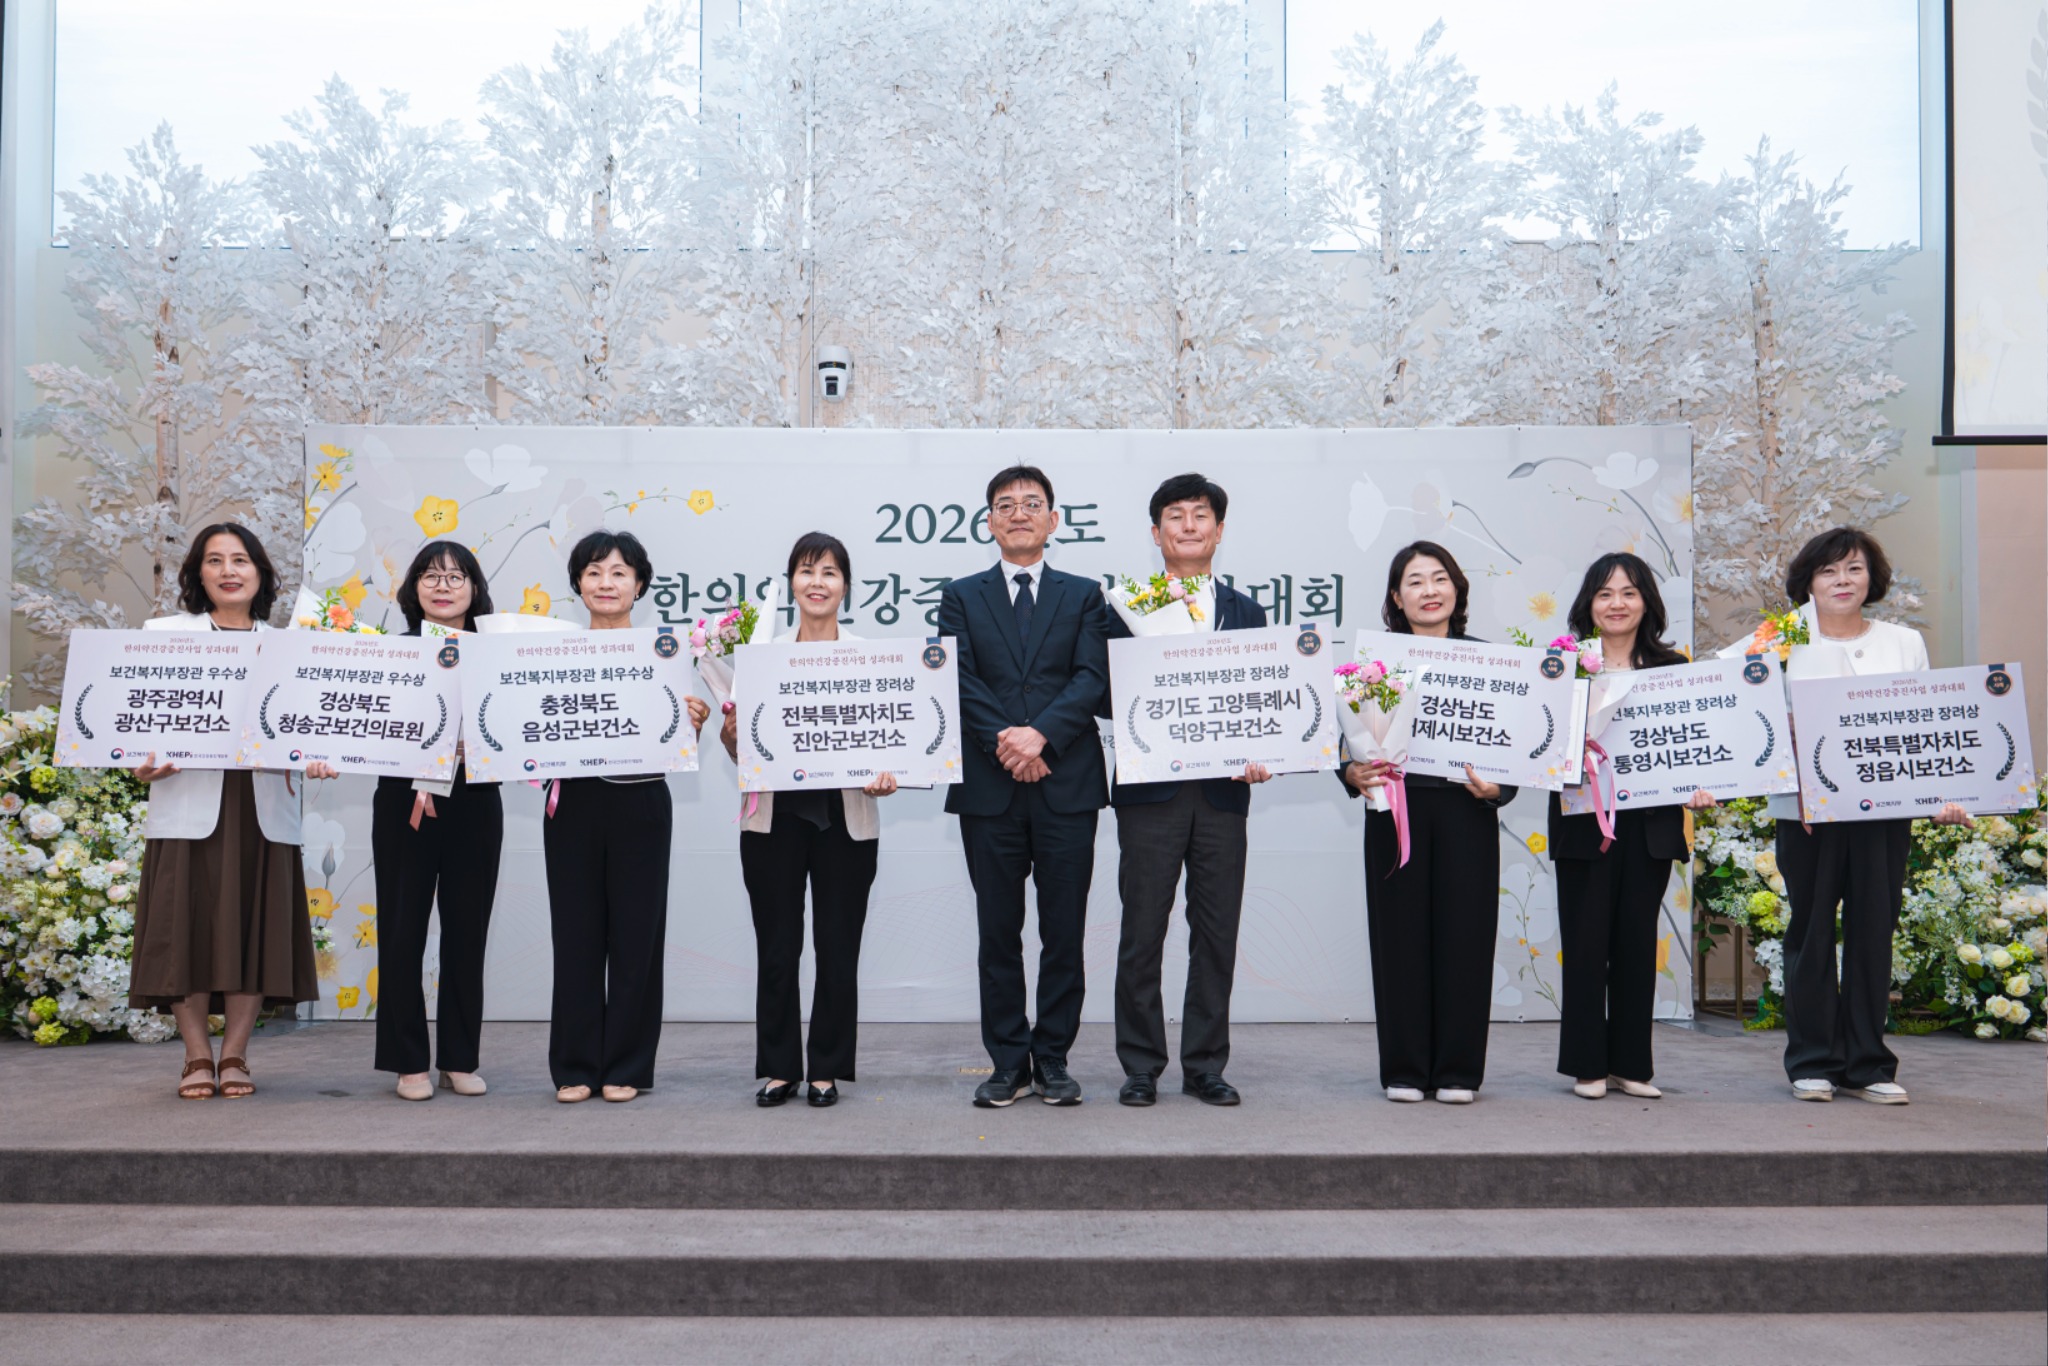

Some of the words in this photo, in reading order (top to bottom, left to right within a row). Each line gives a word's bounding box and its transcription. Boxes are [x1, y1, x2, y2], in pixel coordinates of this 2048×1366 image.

[875, 503, 1106, 549] 2026도
[124, 644, 201, 654] 한의약건강증진사업
[205, 645, 238, 654] 성과대회
[312, 645, 384, 658] 한의약건강증진사업
[387, 649, 419, 660] 성과대회
[517, 645, 596, 657] 한의약건강증진사업
[600, 643, 634, 654] 성과대회
[1163, 646, 1239, 659] 한의약건강증진사업
[1244, 642, 1277, 653] 성과대회
[1408, 648, 1484, 664] 한의약건강증진사업
[1488, 657, 1520, 668] 성과대회
[789, 656, 866, 667] 한의약건강증진사업
[869, 655, 903, 664] 성과대회
[109, 666, 204, 680] 보건복지부장관
[207, 667, 248, 680] 우수상
[295, 666, 384, 684] 보건복지부장관
[387, 673, 426, 687] 우수상
[500, 669, 595, 686] 보건복지부장관
[601, 666, 654, 681] 최우수상
[1154, 669, 1246, 687] 보건복지부장관
[1250, 664, 1290, 681] 장려상
[1688, 674, 1722, 687] 성과대회
[779, 679, 871, 695] 보건복지부장관
[876, 677, 915, 692] 장려상
[1490, 679, 1529, 695] 장려상
[1847, 686, 1926, 700] 한의약건강증진사업
[1930, 682, 1965, 694] 성과대회
[127, 689, 223, 710] 광주광역시
[320, 692, 391, 714] 경상북도
[540, 693, 619, 715] 충청북도
[1146, 697, 1202, 720] 경기도
[1207, 688, 1301, 714] 고양특례시
[1421, 695, 1495, 720] 경상남도
[1612, 699, 1691, 721] 건복지부장관
[1695, 694, 1737, 712] 장려상
[114, 713, 230, 733] 광산구보건소
[782, 703, 915, 727] 전북특별자치도
[1839, 708, 1934, 728] 보건복지부장관
[1938, 704, 1979, 722] 장려상
[278, 714, 425, 742] 청송군보건의료원
[522, 718, 640, 742] 음성군보건소
[1169, 717, 1282, 743] 덕양구보건소
[1630, 722, 1710, 748] 경상남도
[793, 729, 906, 752] 진안군보건소
[1843, 730, 1981, 758] 전북특별자치도
[1614, 744, 1734, 775] 통영시보건소
[1856, 755, 1975, 783] 정읍시보건소
